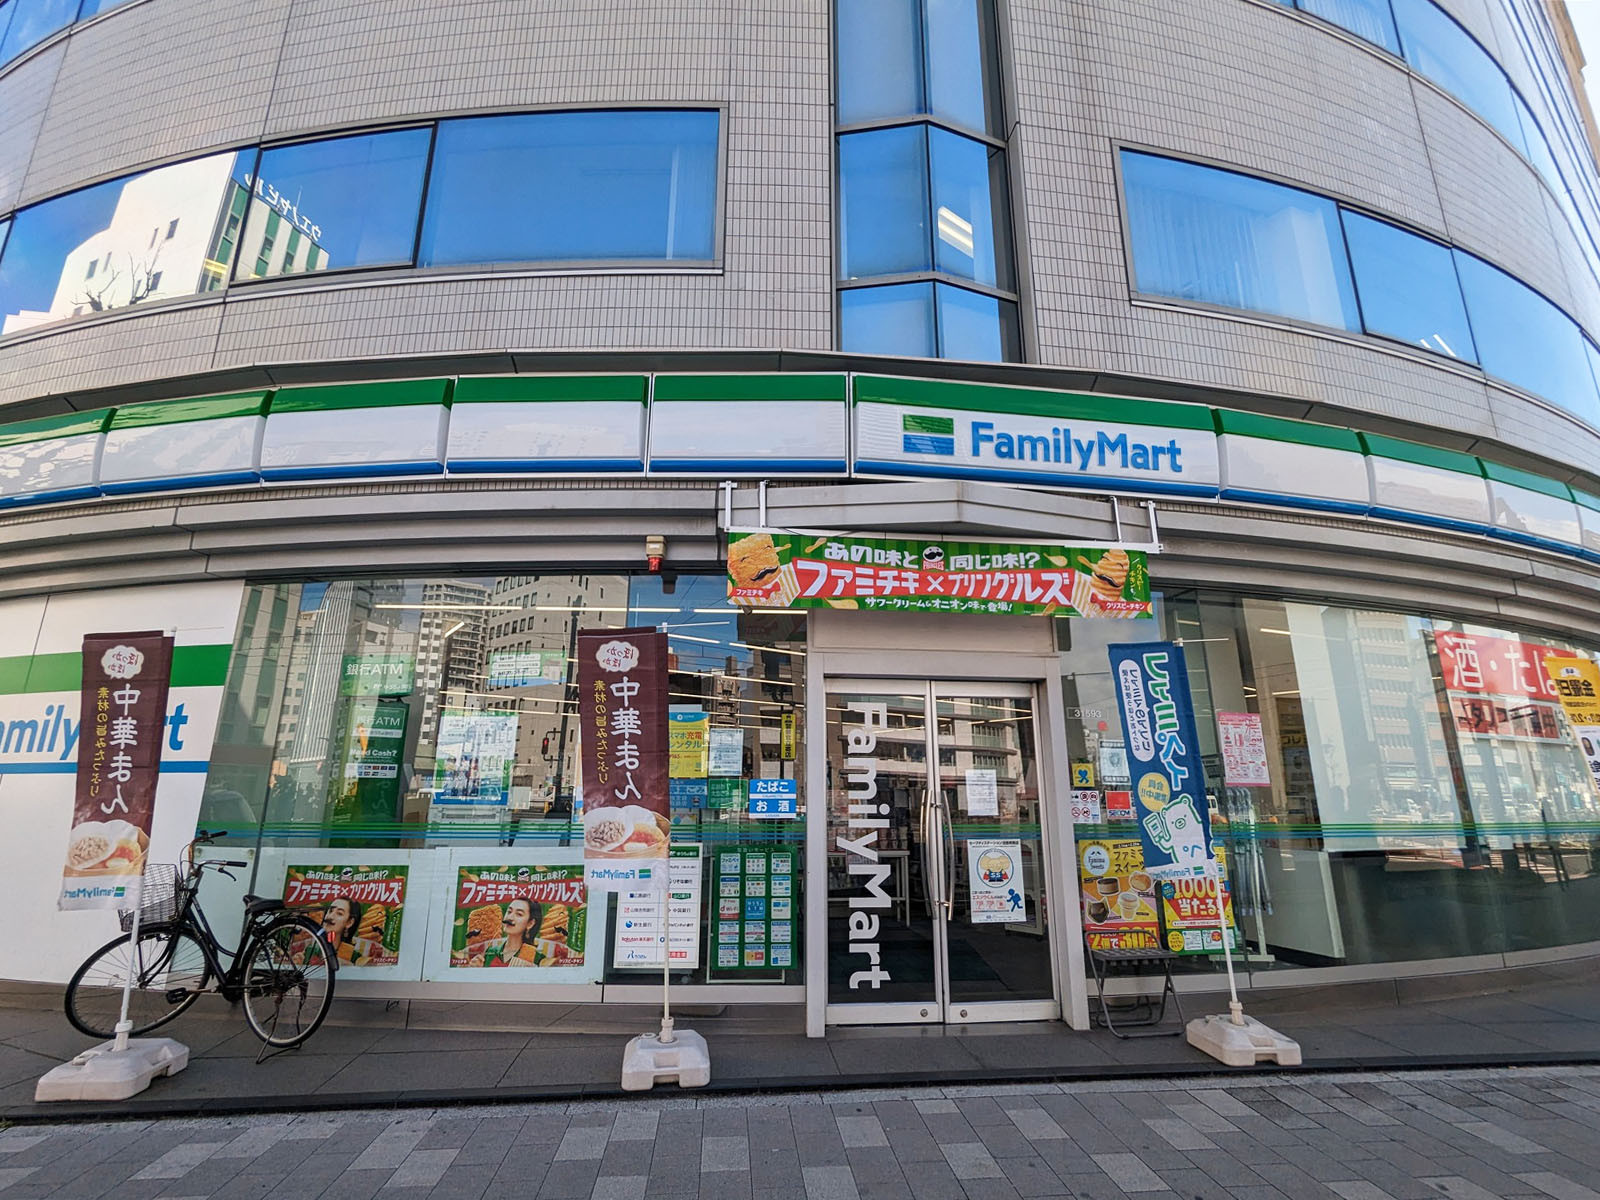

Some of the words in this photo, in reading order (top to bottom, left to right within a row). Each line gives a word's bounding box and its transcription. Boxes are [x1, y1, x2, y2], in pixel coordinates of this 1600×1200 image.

[971, 421, 1182, 472] FamilyMart
[825, 542, 919, 569] あの味と
[736, 588, 763, 596] ファミチキ
[1106, 602, 1145, 610] クリスピーチキン
[372, 749, 397, 757] Cash?
[756, 782, 789, 792] たばこ
[756, 801, 768, 812] お
[778, 801, 790, 812] 酒
[836, 701, 892, 989] FamilyMart
[480, 871, 516, 882] あの味と
